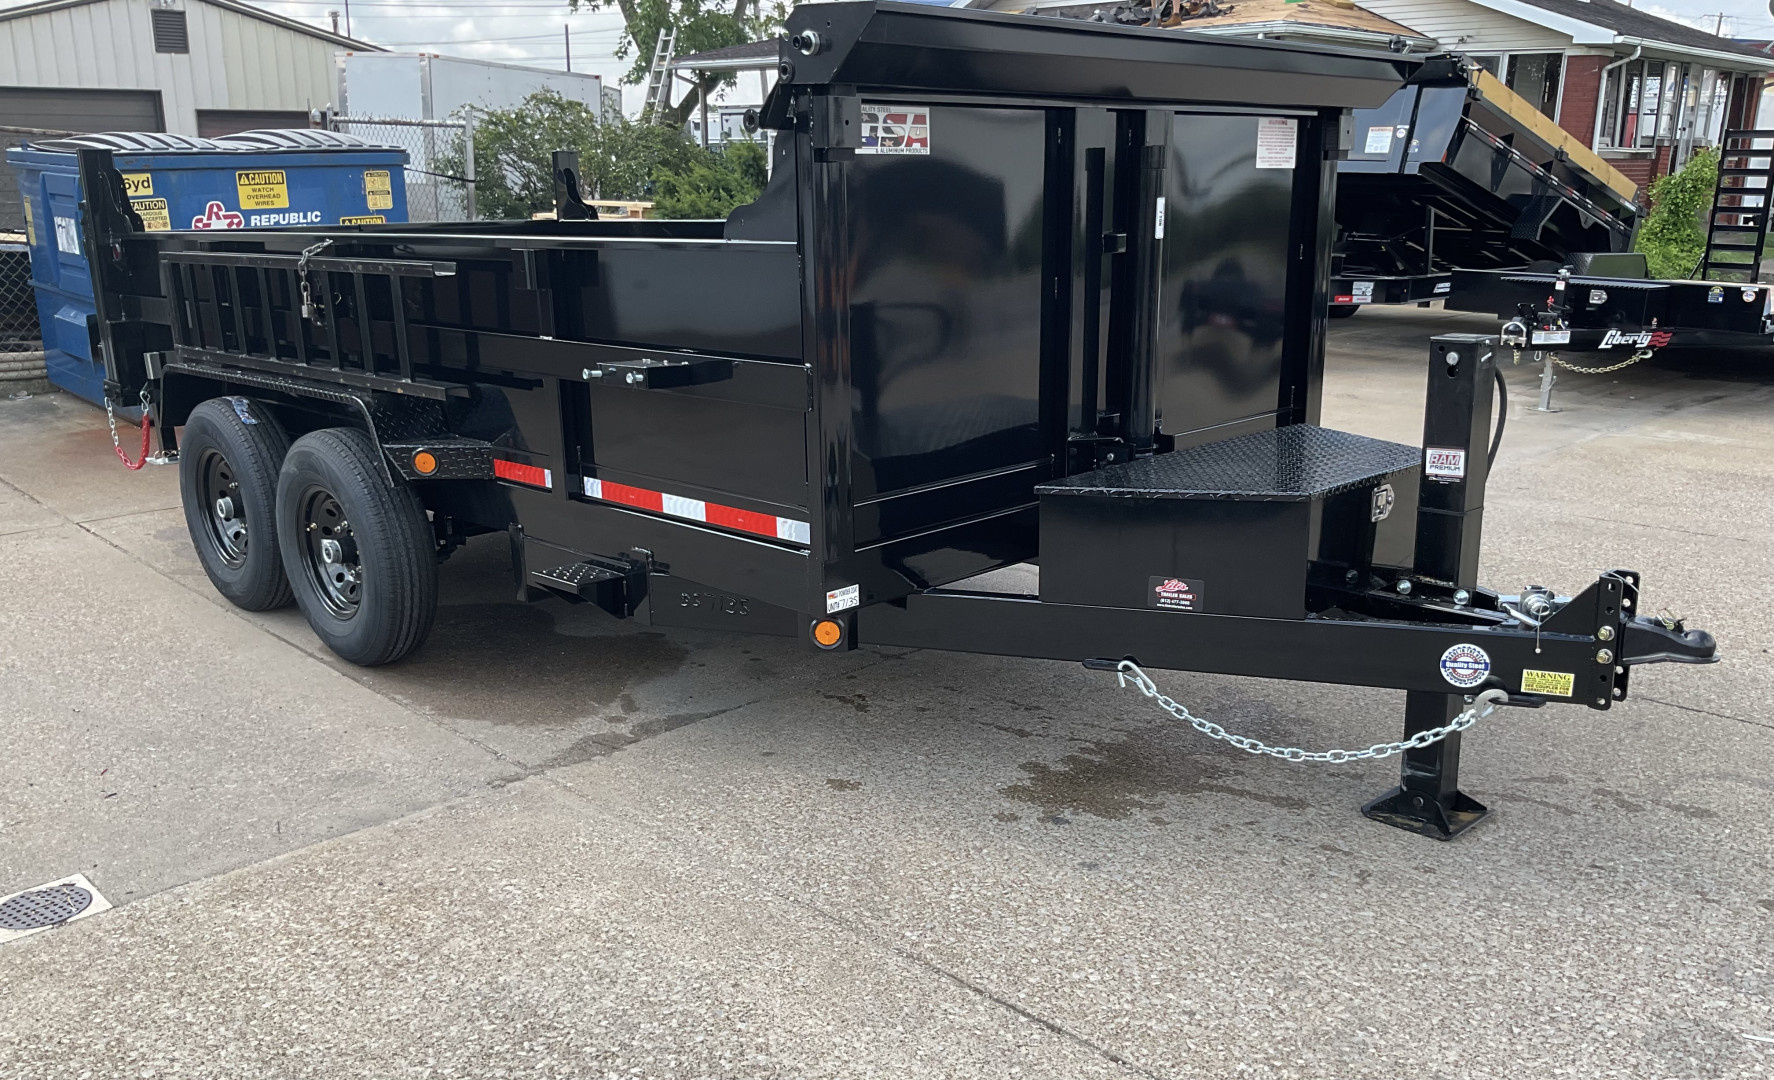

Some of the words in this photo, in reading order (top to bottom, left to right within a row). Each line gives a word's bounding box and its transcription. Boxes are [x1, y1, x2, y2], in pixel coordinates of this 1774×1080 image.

[248, 172, 283, 184] CAUTION
[124, 176, 151, 193] 6yd
[131, 201, 165, 211] AUTION
[250, 211, 321, 227] REPUBLIC
[1598, 330, 1653, 349] Liberty
[1429, 454, 1461, 466] RAM
[1445, 661, 1468, 669] Quality
[1467, 662, 1485, 670] Steel
[1526, 671, 1571, 681] WARNING
